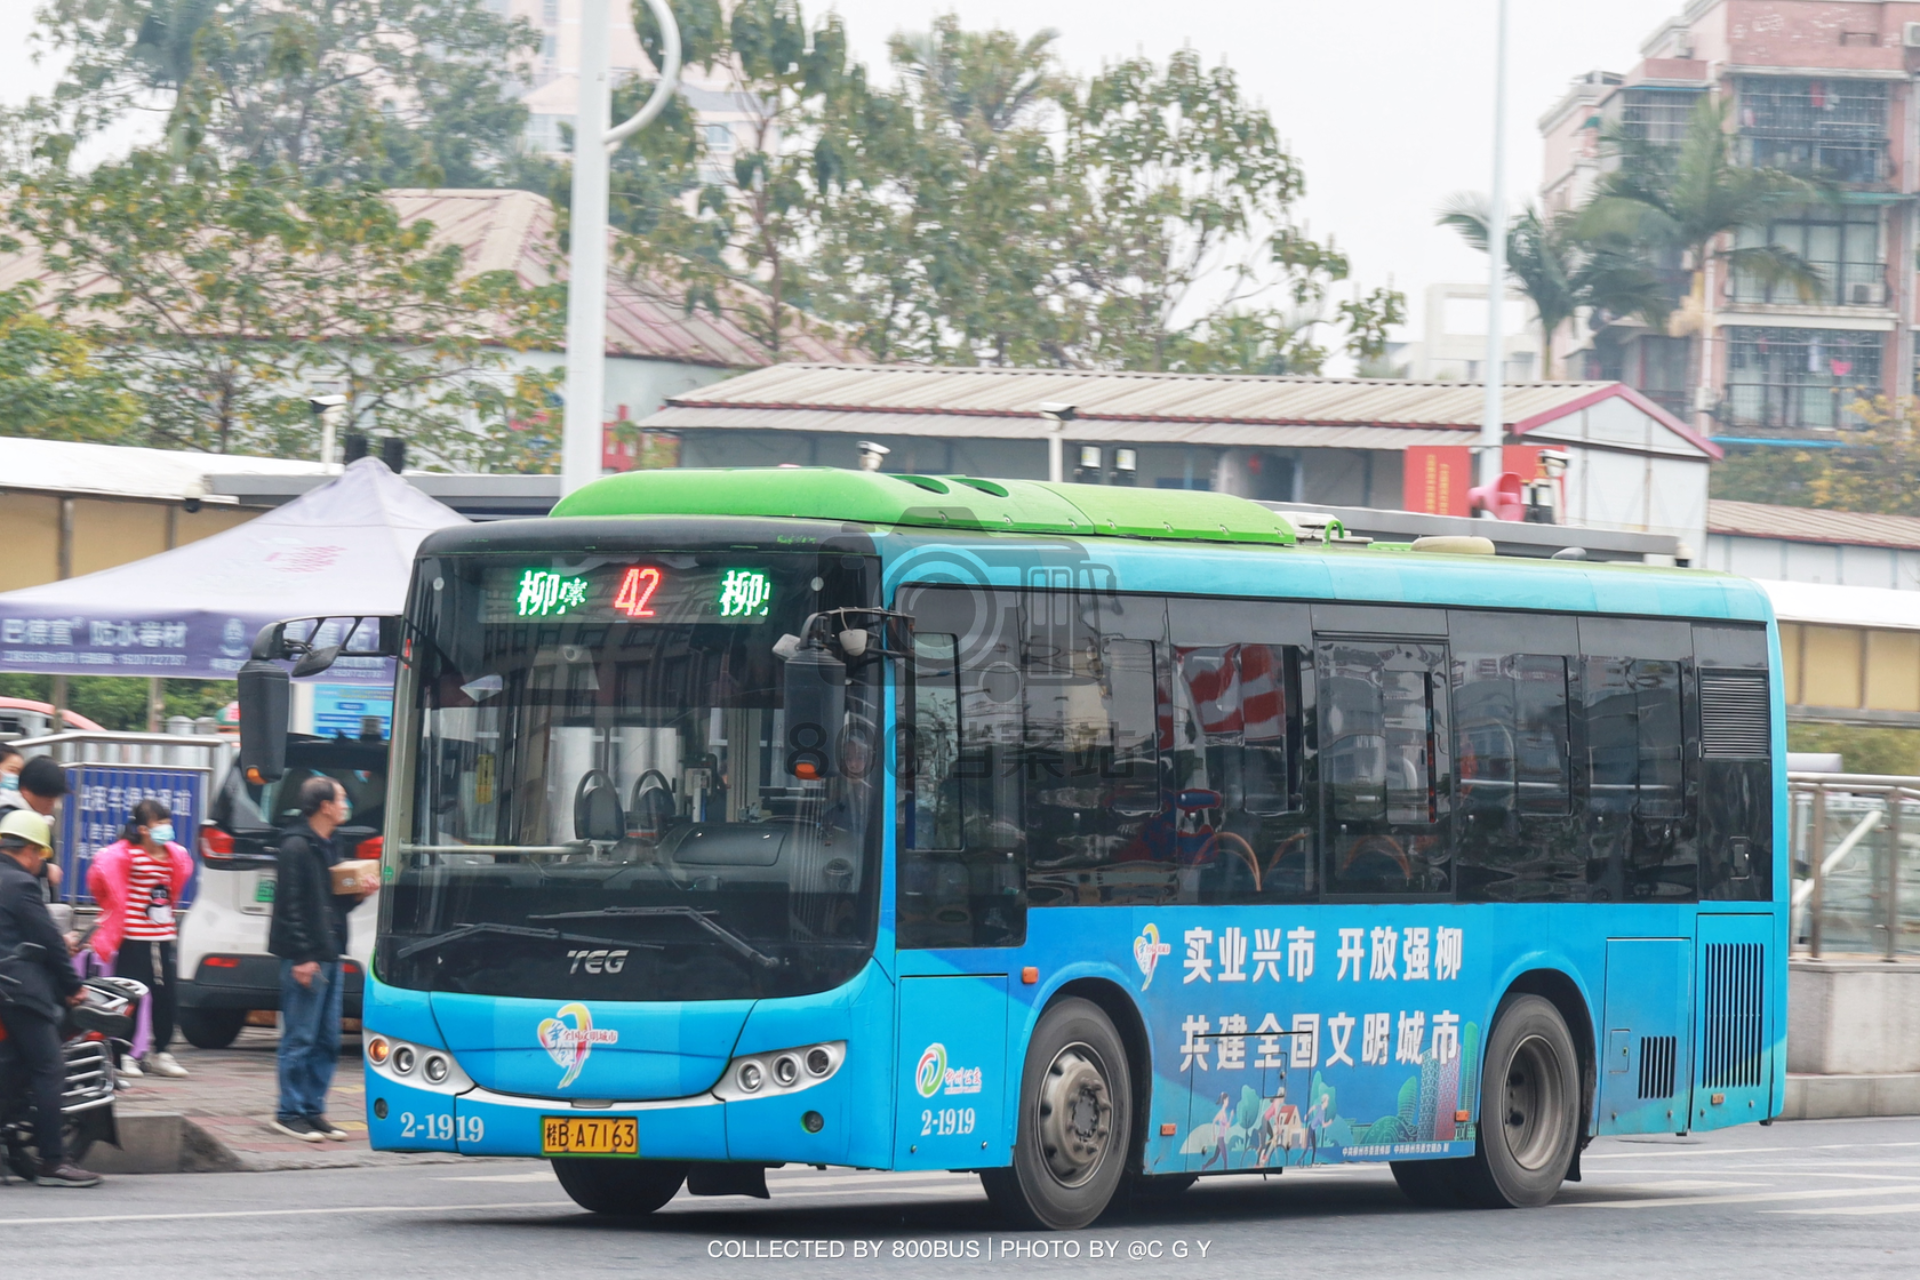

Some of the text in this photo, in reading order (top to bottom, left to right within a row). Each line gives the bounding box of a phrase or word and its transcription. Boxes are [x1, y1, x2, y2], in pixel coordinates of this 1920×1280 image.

[614, 568, 660, 616] 42
[567, 949, 630, 974] TEG
[1183, 925, 1463, 984] 实业兴市 开放强柳
[1180, 1010, 1460, 1073] 共建全国文明城市
[400, 1112, 485, 1143] 2-1919
[920, 1107, 976, 1136] 2-1919
